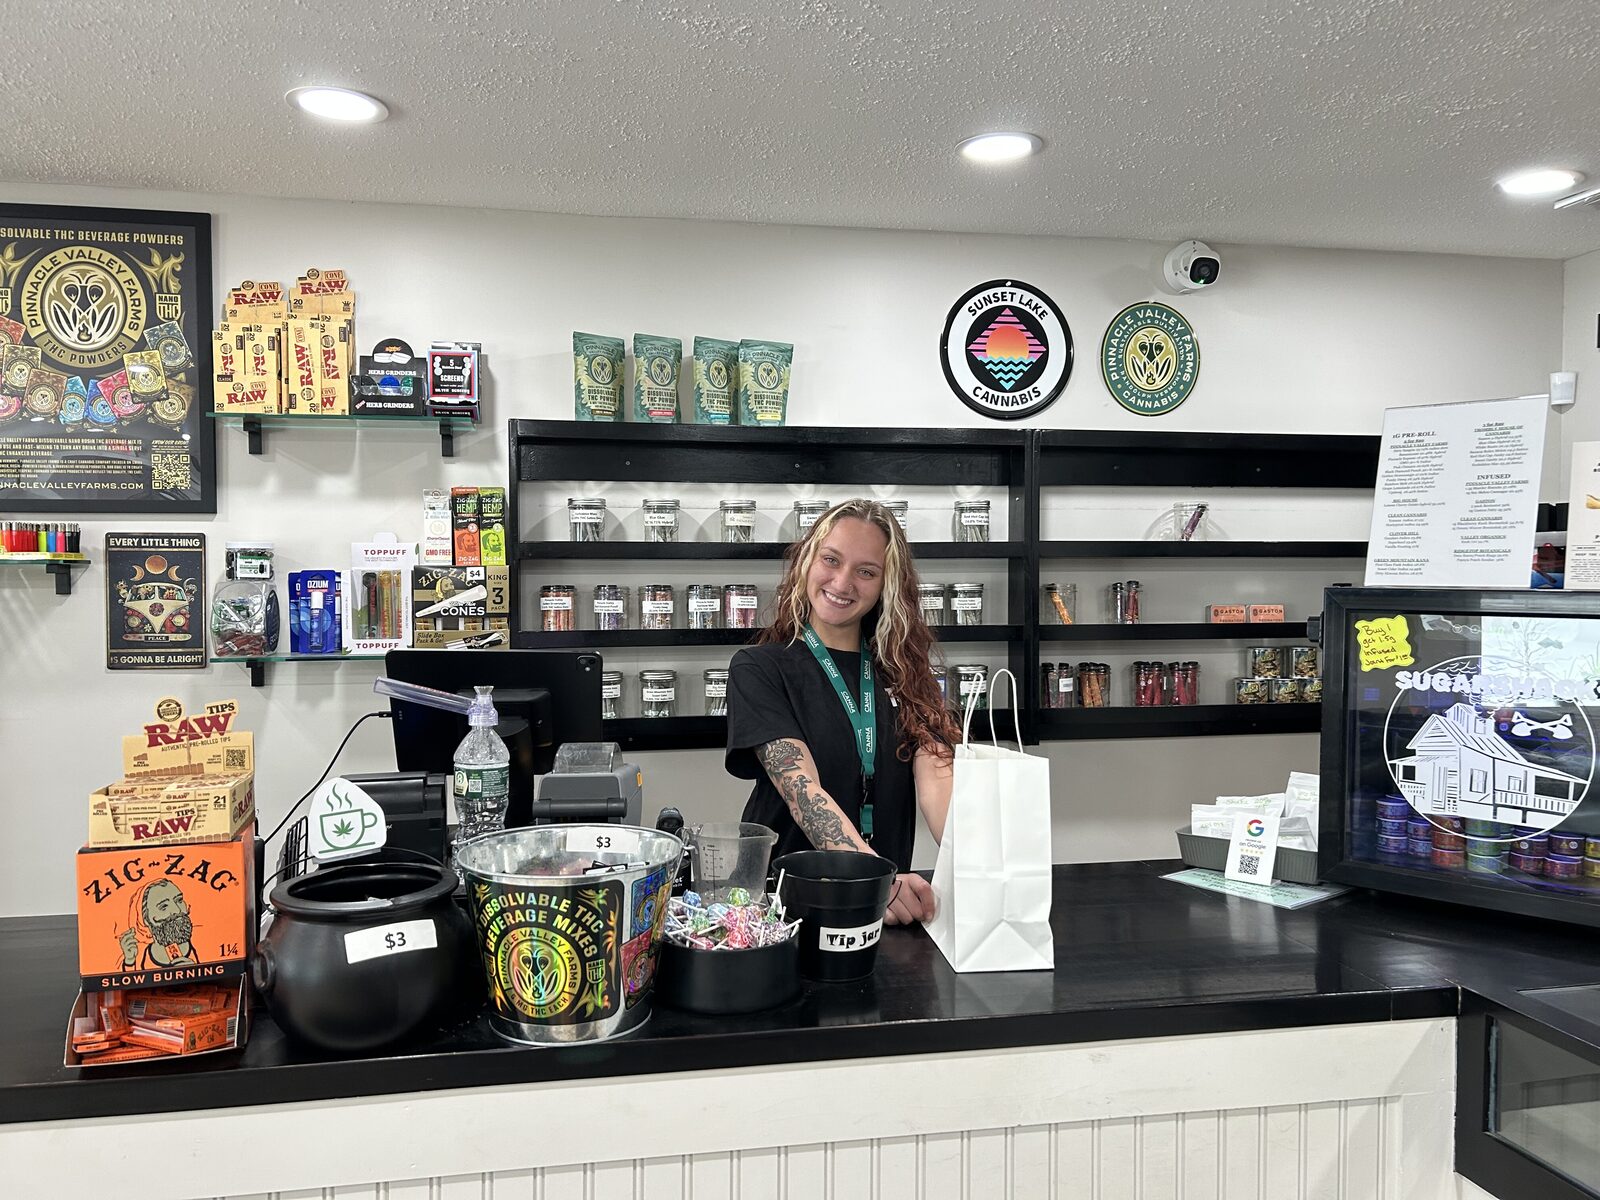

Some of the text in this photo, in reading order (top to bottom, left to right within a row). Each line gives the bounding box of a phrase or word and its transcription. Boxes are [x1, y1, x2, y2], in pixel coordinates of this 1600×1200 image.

[54, 229, 75, 240] THC
[78, 231, 130, 243] BEVERAGE
[133, 233, 184, 246] POWDERS
[26, 249, 143, 331] PINNACLE VALLEY FARMS
[299, 280, 347, 295] RAW
[157, 295, 179, 303] NANO
[232, 290, 282, 306] RAW
[967, 291, 1049, 321] SUNSET LAKE
[158, 304, 179, 321] THC
[43, 339, 128, 365] THC POWDERS
[1107, 309, 1194, 383] PINNACLE VALLEY FARMS
[294, 343, 314, 387] RAW
[449, 358, 455, 367] 5
[440, 374, 464, 382] SCREENS
[226, 389, 267, 405] RAW
[972, 386, 1042, 407] CANNABIS
[1122, 390, 1179, 409] CANNABIS
[309, 402, 316, 413] 20
[456, 503, 477, 513] HEMP
[482, 503, 503, 514] HEMP
[109, 538, 200, 547] EVERY LITTLE THING
[425, 548, 438, 556] GMO
[418, 567, 473, 587] ZIG-ZAG
[469, 569, 480, 578] $4
[307, 580, 329, 589] OZIUM
[492, 587, 504, 605] 3
[440, 606, 485, 616] CONES
[1361, 623, 1391, 637] Buy 1
[1362, 637, 1376, 649] get
[110, 656, 119, 664] IS
[120, 656, 153, 664] GONNA
[166, 655, 203, 663] ALRIGHT
[822, 656, 839, 679] CANNA
[863, 659, 871, 681] CANNA
[206, 702, 235, 715] TIPS
[840, 690, 856, 714] CANNA
[863, 691, 872, 713] CANNA
[144, 712, 232, 748] RAW
[161, 743, 188, 752] AUTHENTIC
[188, 738, 219, 748] PRE-ROLLED
[865, 726, 873, 754] CANNA
[213, 795, 227, 804] 21
[237, 788, 253, 819] RAW
[174, 808, 196, 817] TIPS
[130, 815, 194, 841] RAW
[595, 836, 611, 849] $3
[83, 853, 236, 904] ZIG-ZAG
[480, 892, 604, 934] DISSOLVABLE THC
[384, 931, 407, 950] $3
[486, 908, 598, 958] BEVERAGE MIXES
[826, 927, 880, 949] Tip jar
[500, 930, 578, 988] PINNACLE VALLEY FARMS
[101, 965, 226, 988] SLOW BURNING
[589, 967, 604, 981] THC
[516, 997, 569, 1015] MG THC EACH
